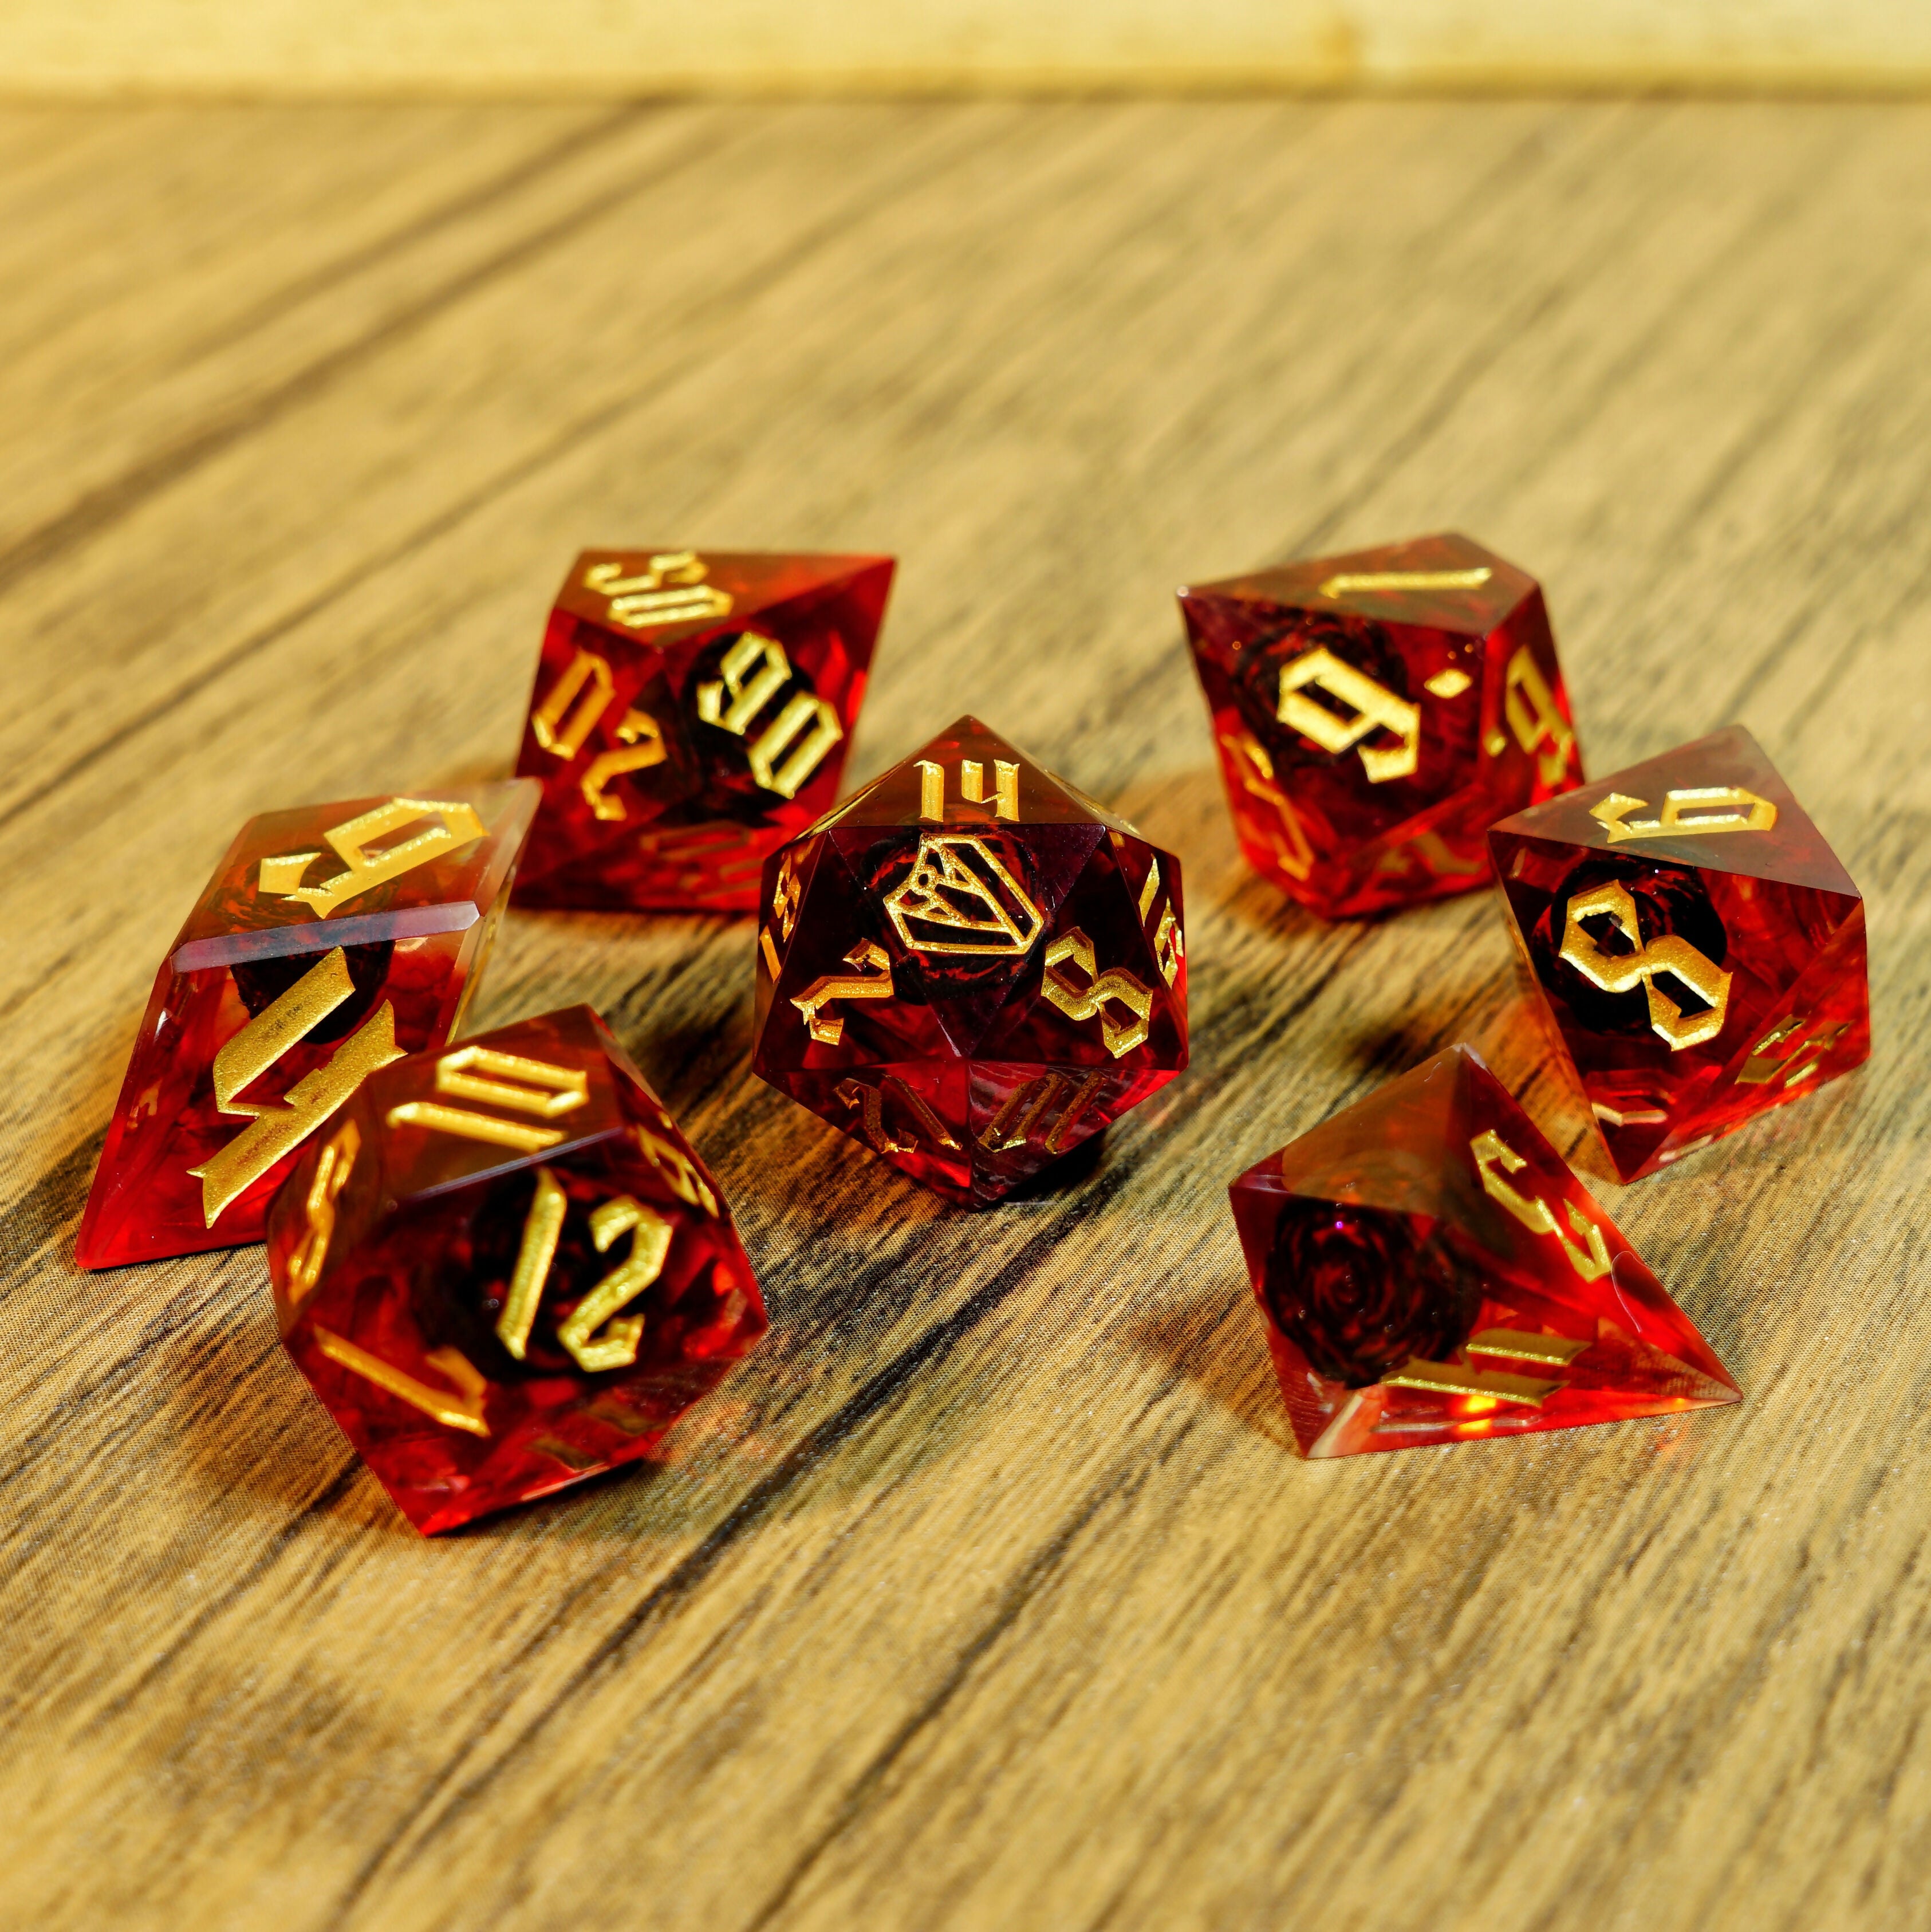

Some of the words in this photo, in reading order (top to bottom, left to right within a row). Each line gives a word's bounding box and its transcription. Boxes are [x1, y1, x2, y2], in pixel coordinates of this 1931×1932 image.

[582, 550, 735, 629] 50
[532, 646, 668, 821] 20
[696, 631, 843, 800] 90
[913, 758, 1020, 823] 14
[759, 852, 803, 985] 18
[1558, 878, 1734, 1053] 8
[790, 938, 894, 1046] 2
[1041, 926, 1154, 1059] 8
[186, 945, 409, 1230] 4
[385, 1046, 590, 1153] 10
[496, 1165, 674, 1373] 12
[1469, 1128, 1613, 1284] 3
